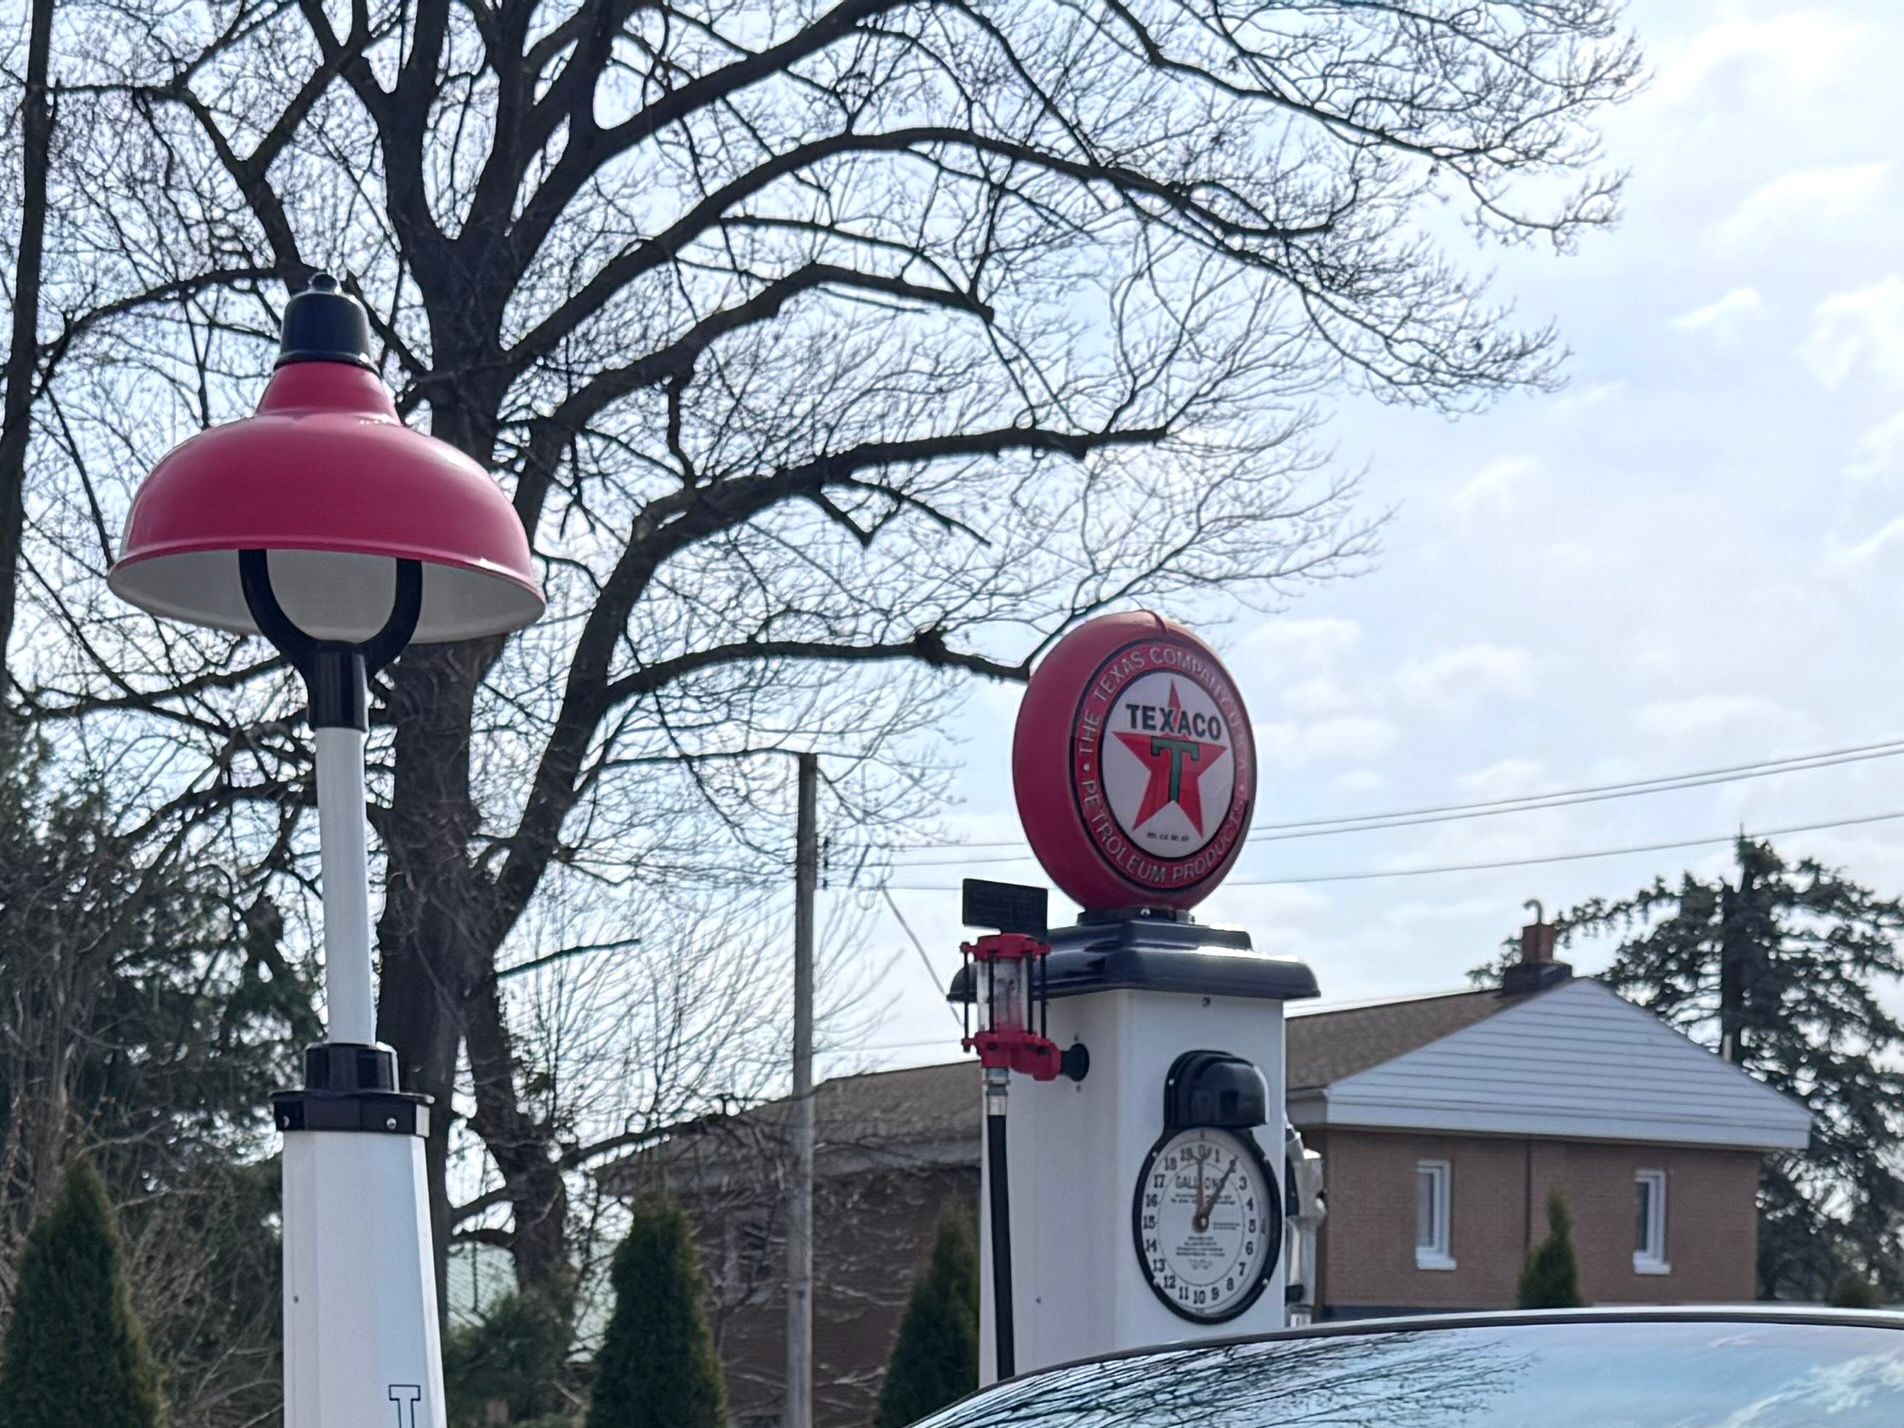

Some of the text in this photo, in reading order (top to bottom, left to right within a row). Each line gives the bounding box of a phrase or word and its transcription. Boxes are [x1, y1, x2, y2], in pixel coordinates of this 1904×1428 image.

[1079, 708, 1100, 754] THE
[1093, 652, 1145, 702] TEXAS
[1125, 703, 1222, 740] TEXACO
[1151, 736, 1201, 803] T
[1154, 1174, 1165, 1188] 17
[1164, 1275, 1176, 1289] 12
[1193, 1290, 1206, 1304] 10
